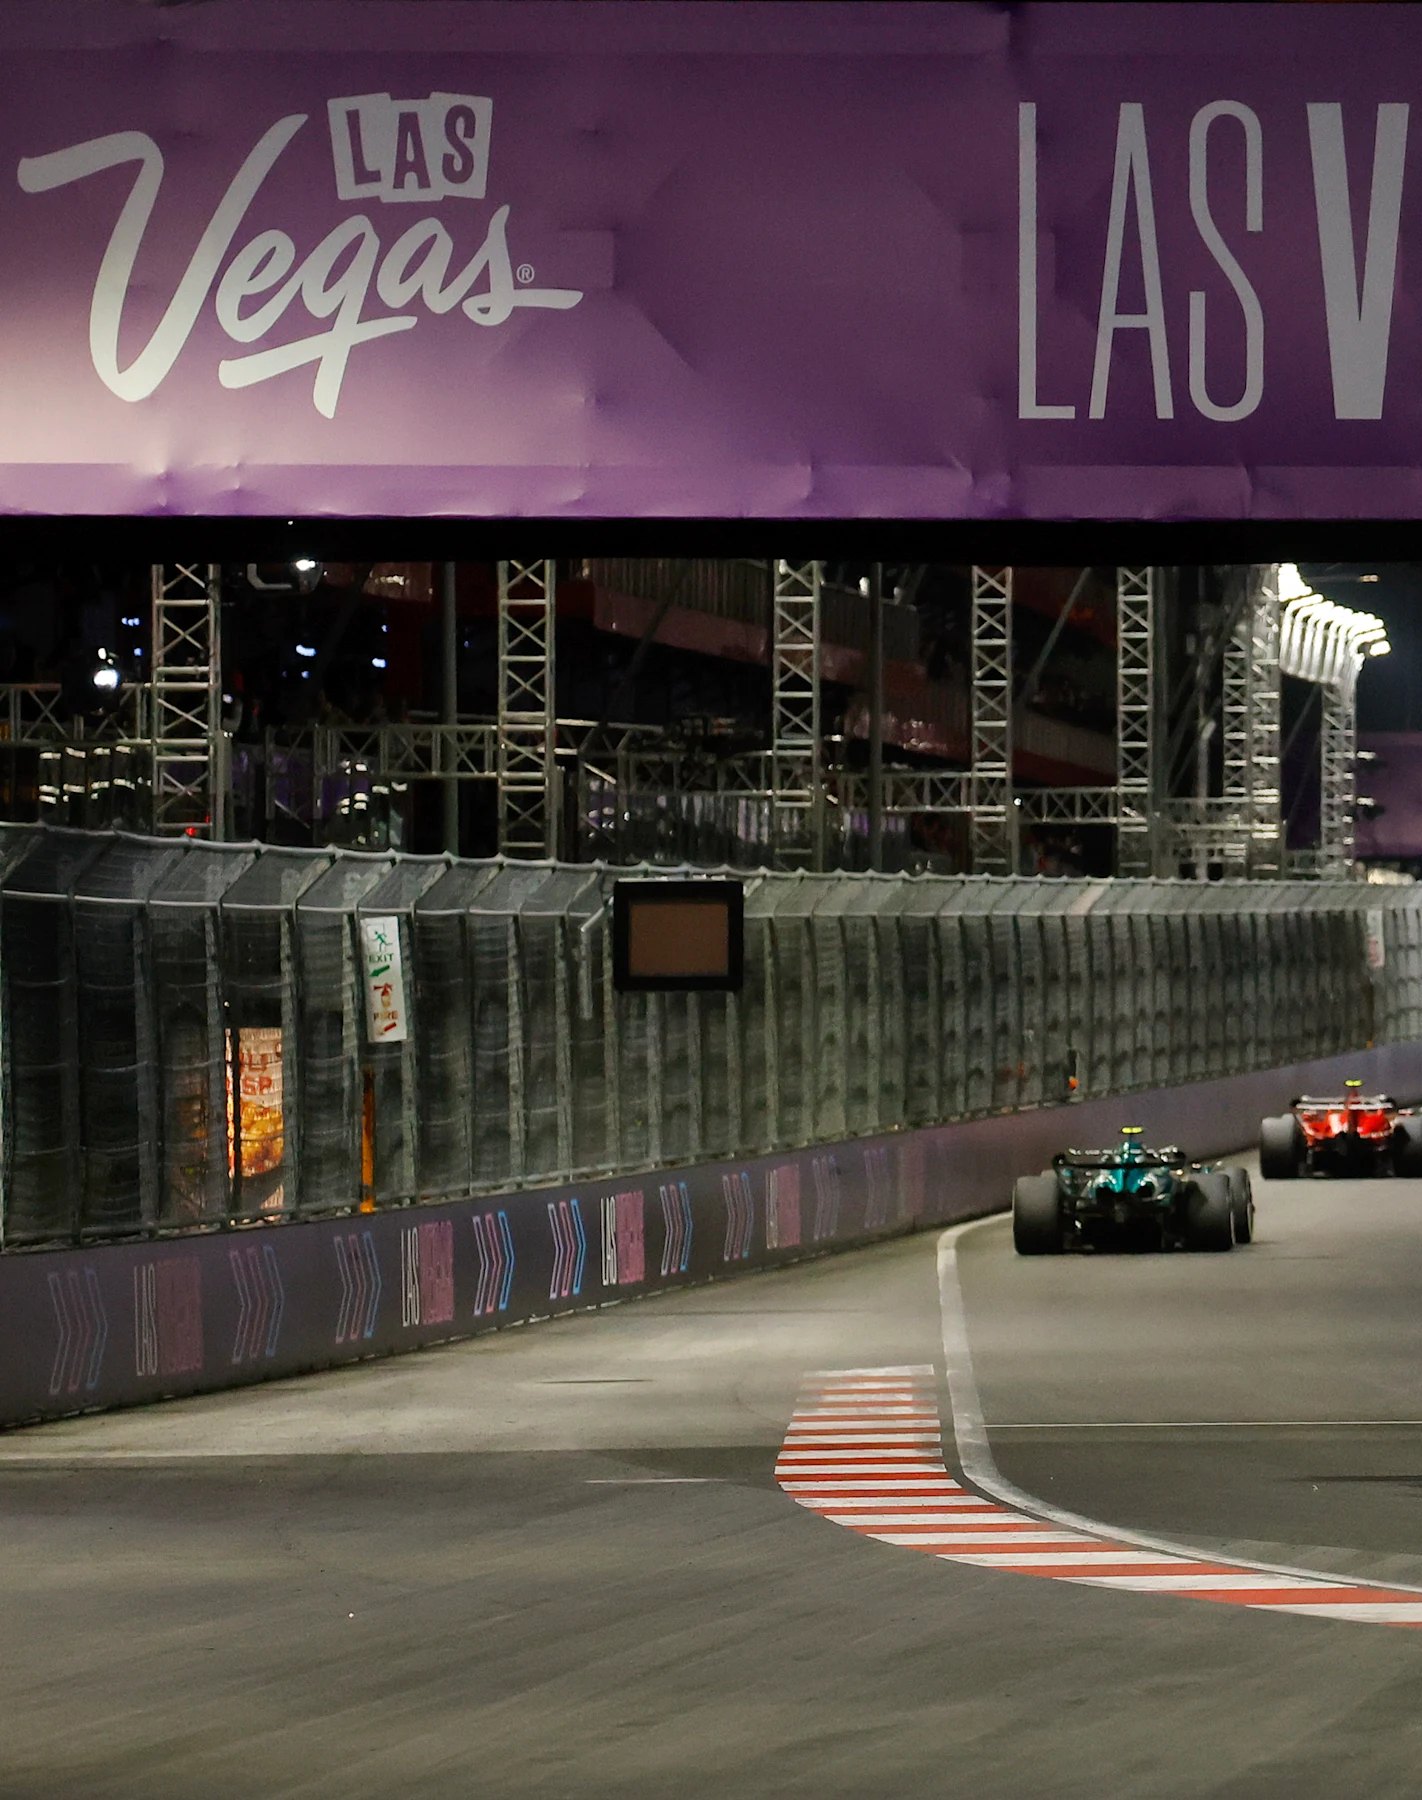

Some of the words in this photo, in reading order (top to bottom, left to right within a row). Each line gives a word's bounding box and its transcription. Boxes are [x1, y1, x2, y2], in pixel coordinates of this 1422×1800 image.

[341, 102, 481, 192] LAS
[17, 114, 583, 419] Vegas
[1019, 100, 1264, 421] LAS
[369, 953, 394, 962] EXIT
